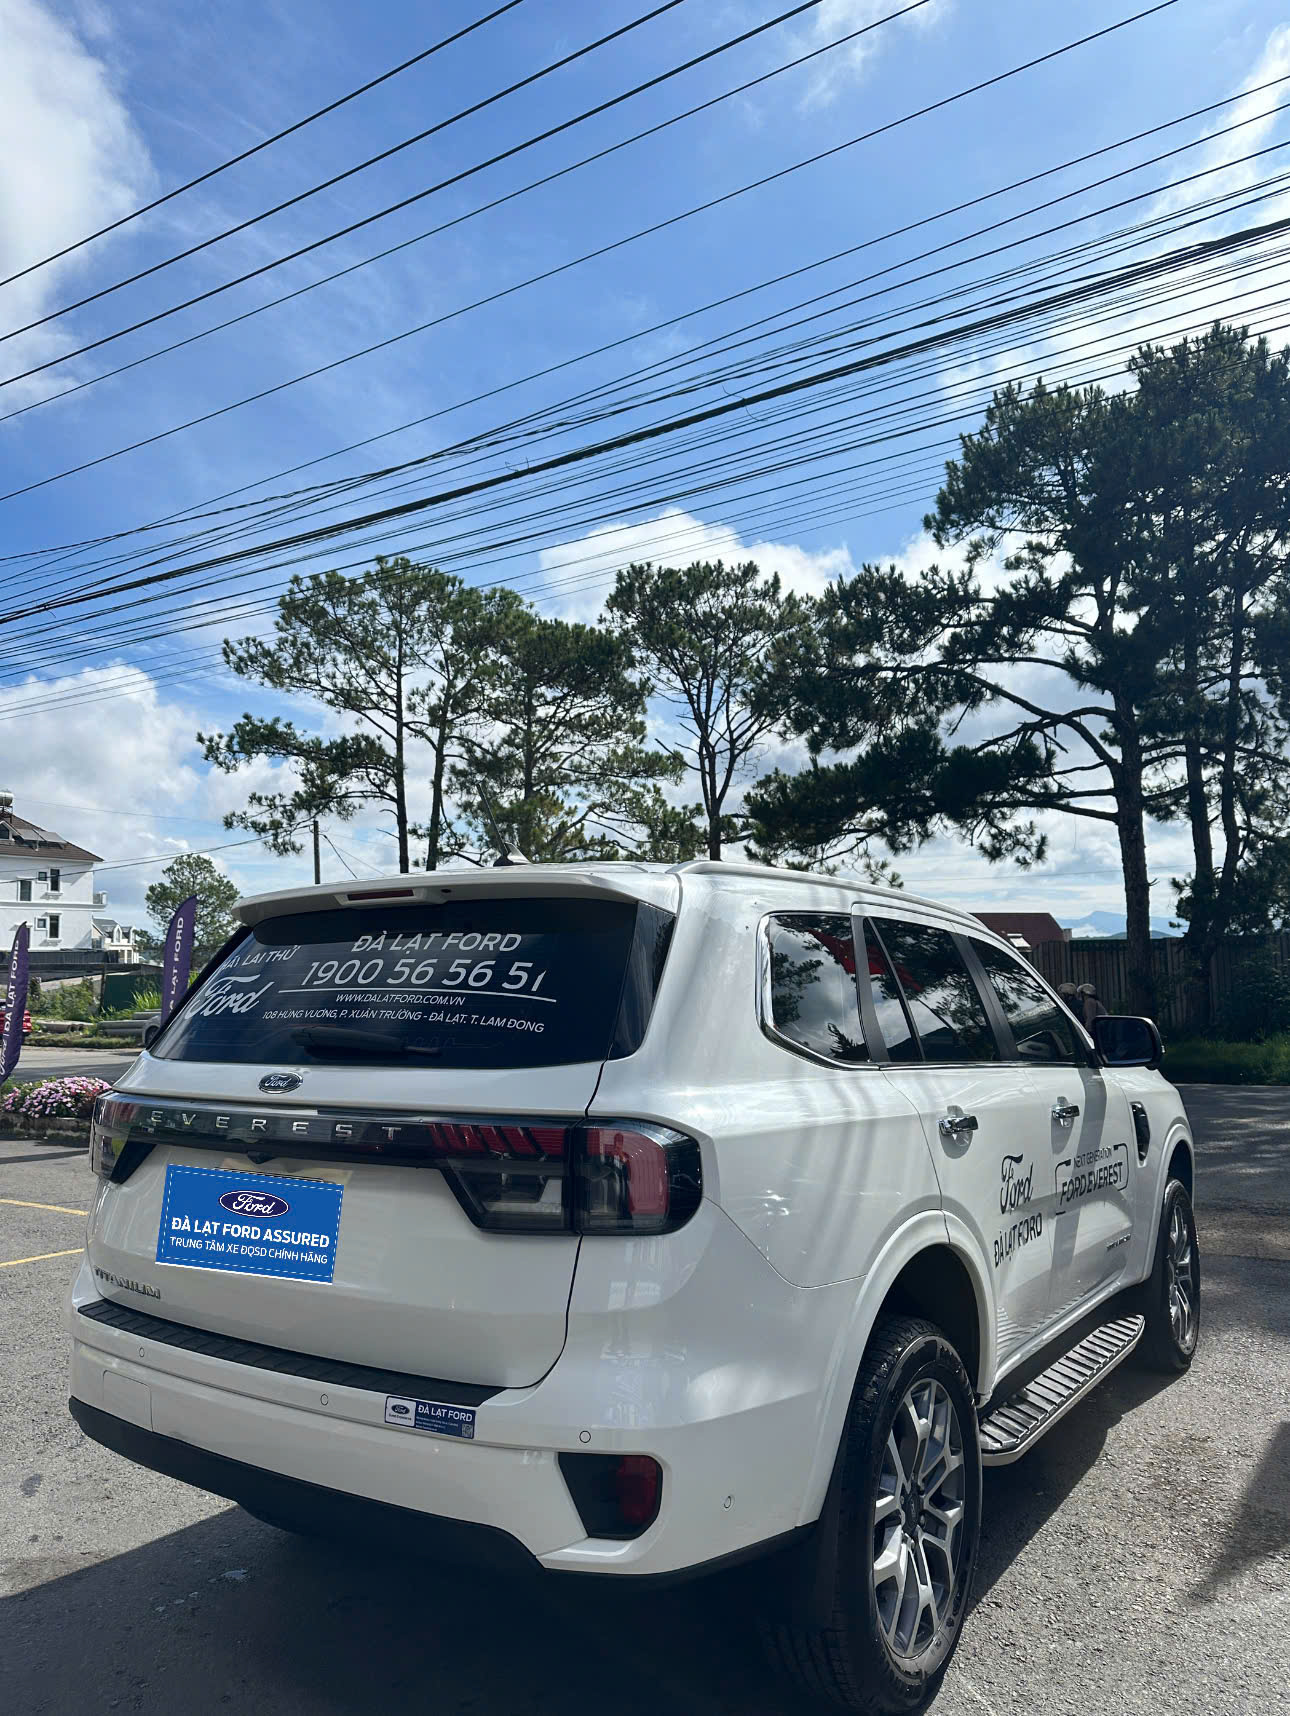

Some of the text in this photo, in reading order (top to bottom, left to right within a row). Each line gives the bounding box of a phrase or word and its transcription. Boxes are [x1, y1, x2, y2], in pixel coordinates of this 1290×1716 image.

[174, 917, 184, 962] FORD
[351, 930, 522, 955] ĐÀ LẠT FORD
[11, 939, 20, 979] FORD
[301, 958, 547, 992] 1900 56 56 51
[185, 974, 275, 1020] Ford
[335, 993, 466, 1006] WWW.DALATFORD.COM.VN
[339, 1009, 348, 1018] P.
[470, 1014, 480, 1025] T.
[150, 1110, 402, 1141] EVEREST
[1000, 1154, 1034, 1214] Ford
[1060, 1162, 1123, 1206] FORD EVEREST
[232, 1193, 275, 1214] Ford
[171, 1215, 330, 1248] ĐÀ LẠT FORD ASSURED
[1018, 1212, 1043, 1248] FORD
[169, 1236, 203, 1250] TRUNG
[205, 1240, 225, 1252] TÂM
[226, 1243, 239, 1254] XE
[268, 1248, 299, 1262] CHÍNH
[418, 1404, 473, 1422] ĐÀ LẠT FORD
